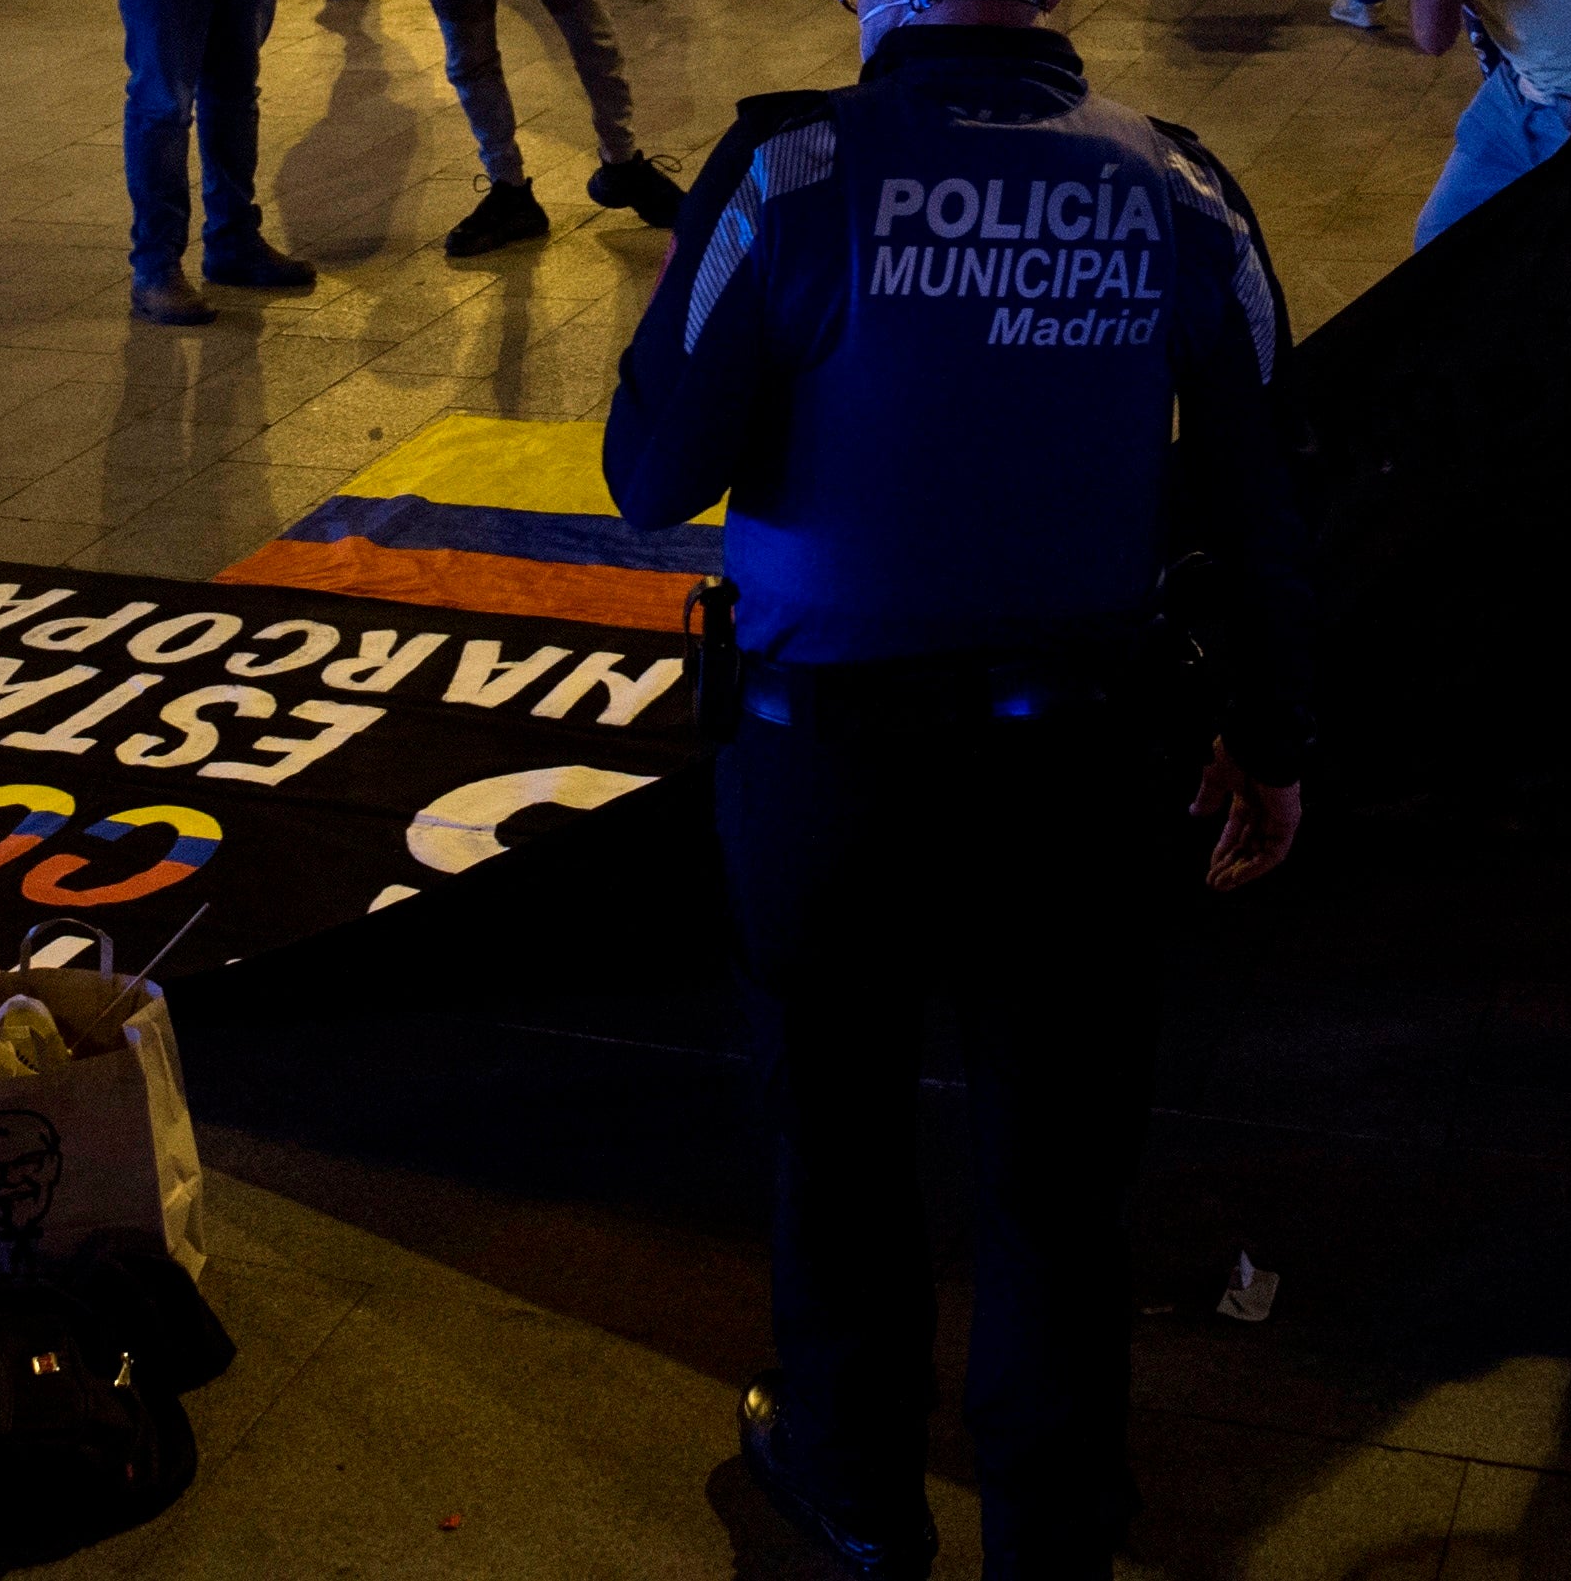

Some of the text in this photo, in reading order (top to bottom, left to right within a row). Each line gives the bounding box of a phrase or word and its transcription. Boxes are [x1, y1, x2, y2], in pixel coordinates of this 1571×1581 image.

[874, 163, 1163, 242] POLICÍA
[869, 245, 1164, 300] MUNICIPAL
[986, 306, 1161, 347] Madrid
